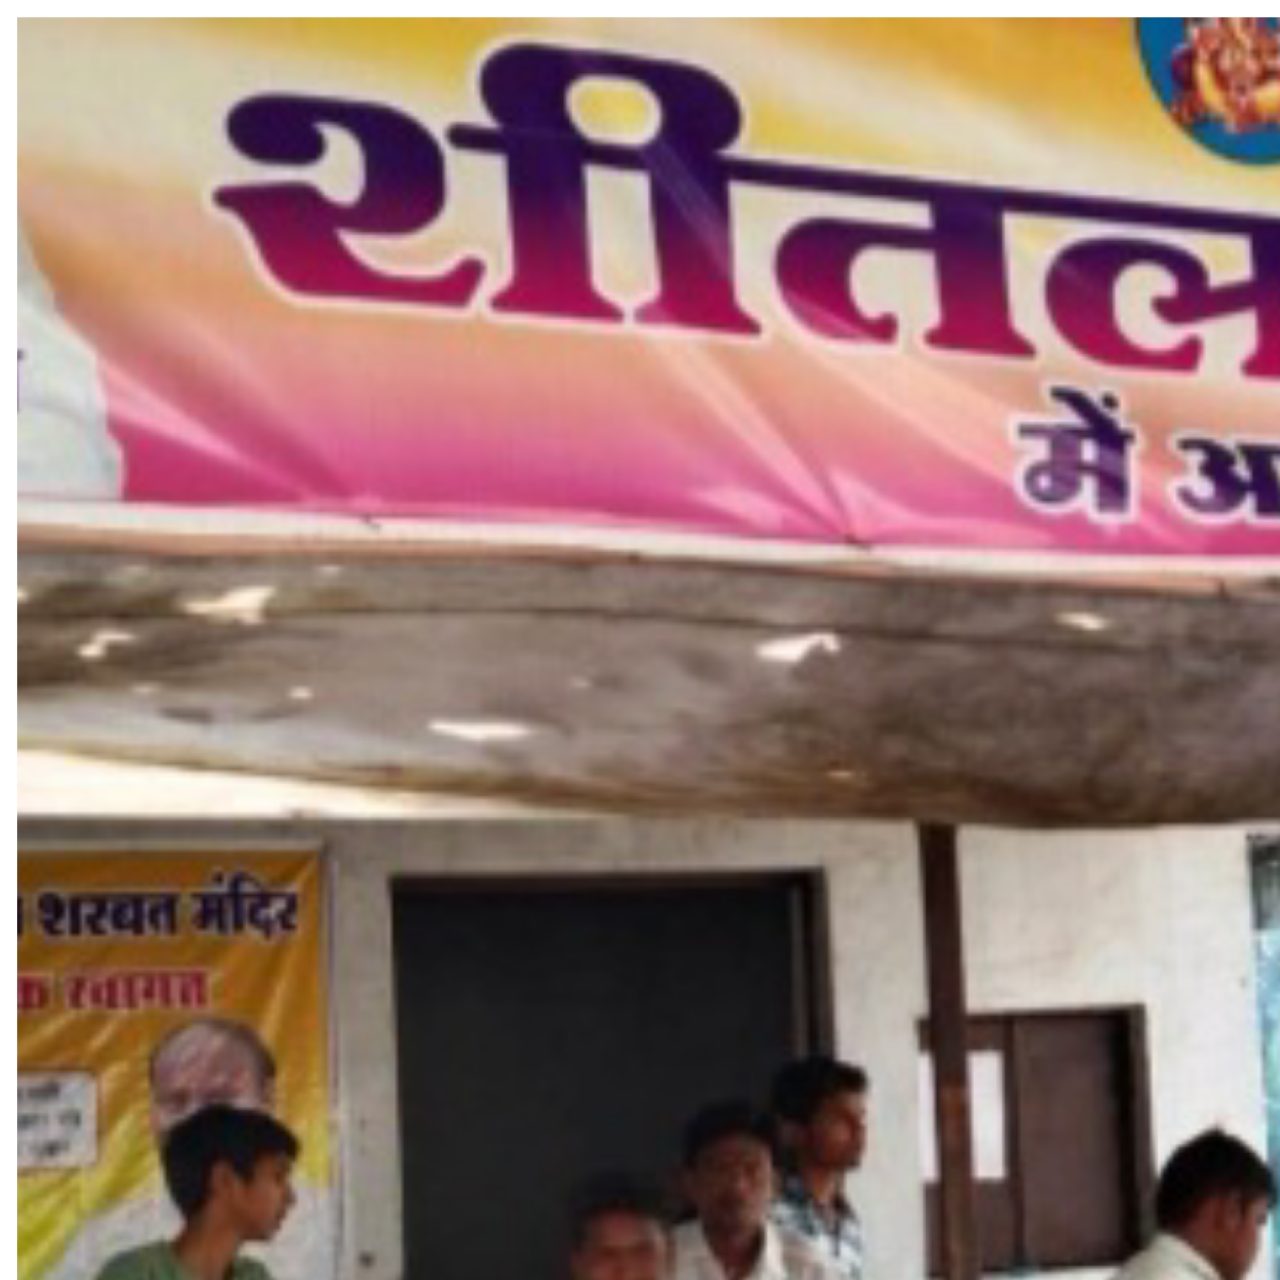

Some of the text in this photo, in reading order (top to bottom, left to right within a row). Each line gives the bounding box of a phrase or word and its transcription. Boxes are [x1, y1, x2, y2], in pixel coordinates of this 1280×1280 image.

[1016, 386, 1133, 514] में
[38, 892, 178, 936] शरबत
[190, 872, 298, 938] मंदिर
